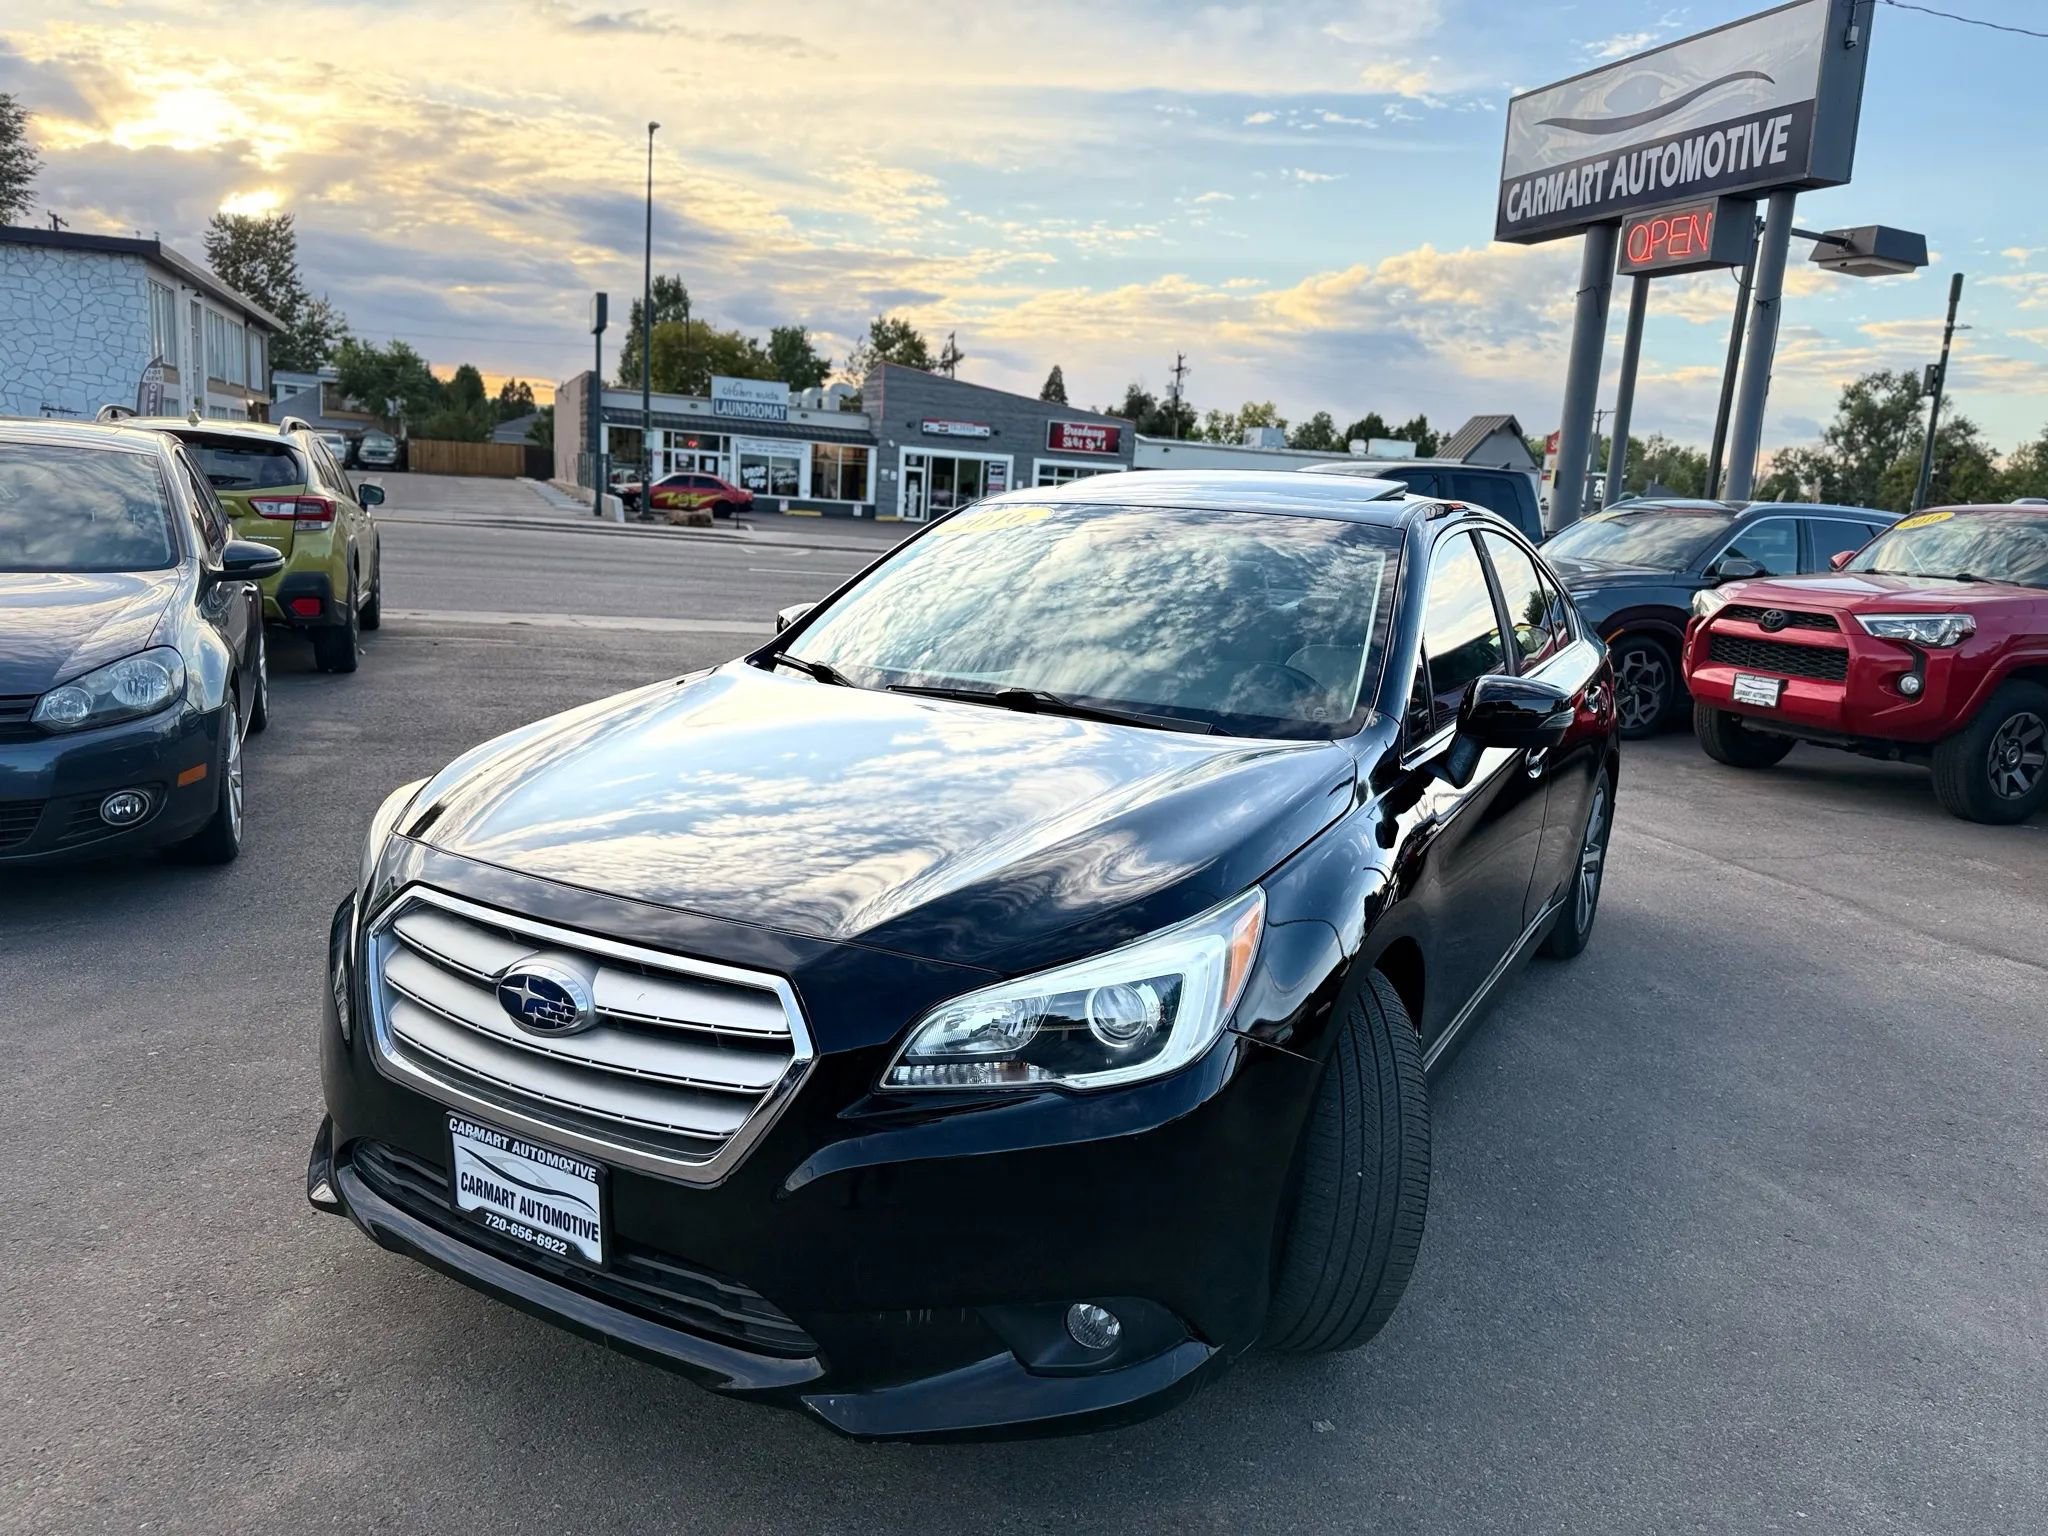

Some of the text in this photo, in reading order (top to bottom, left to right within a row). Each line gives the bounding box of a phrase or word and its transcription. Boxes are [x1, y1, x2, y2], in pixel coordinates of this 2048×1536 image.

[1506, 113, 1793, 223] CARMART AUTOMOTIVE
[1627, 212, 1713, 263] OPEN
[715, 399, 786, 420] LAUNDROMAT
[742, 466, 767, 479] DROP
[748, 478, 767, 489] OFF
[449, 1118, 597, 1182] CARMART AUTOMOTIVE
[460, 1171, 599, 1243] CARMART AUTOMOTIVE
[485, 1213, 568, 1255] 720-656-6922
